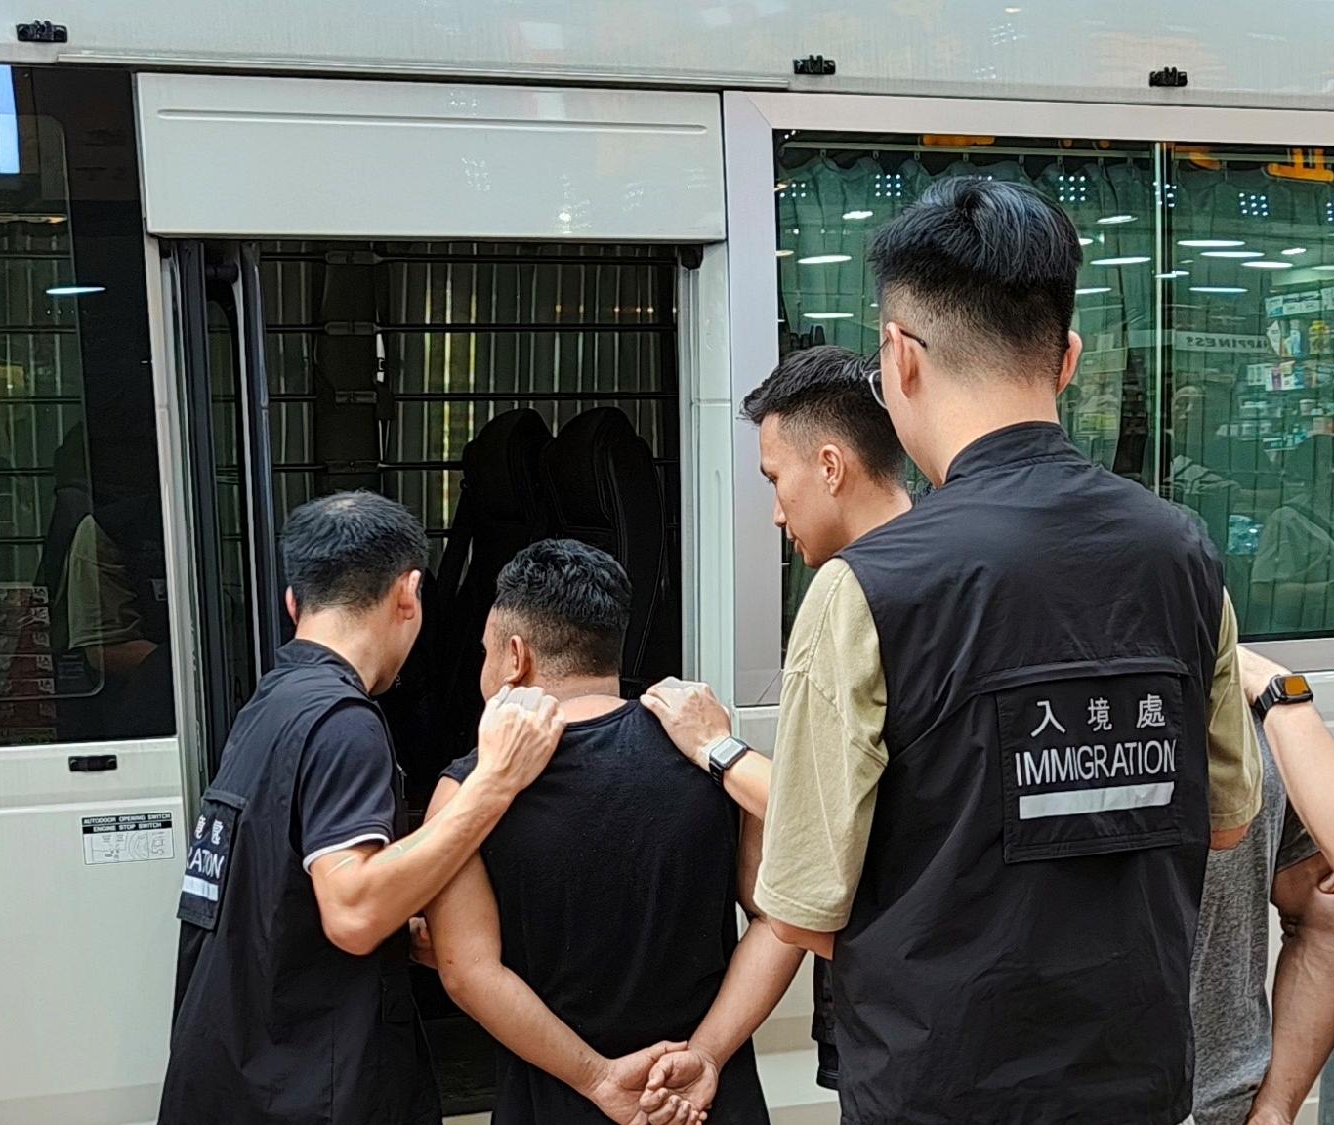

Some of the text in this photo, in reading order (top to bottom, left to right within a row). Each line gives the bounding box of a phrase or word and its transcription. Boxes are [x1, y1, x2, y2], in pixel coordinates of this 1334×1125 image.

[1030, 693, 1167, 738] 入境處
[1015, 739, 1178, 788] IMMIGRATION
